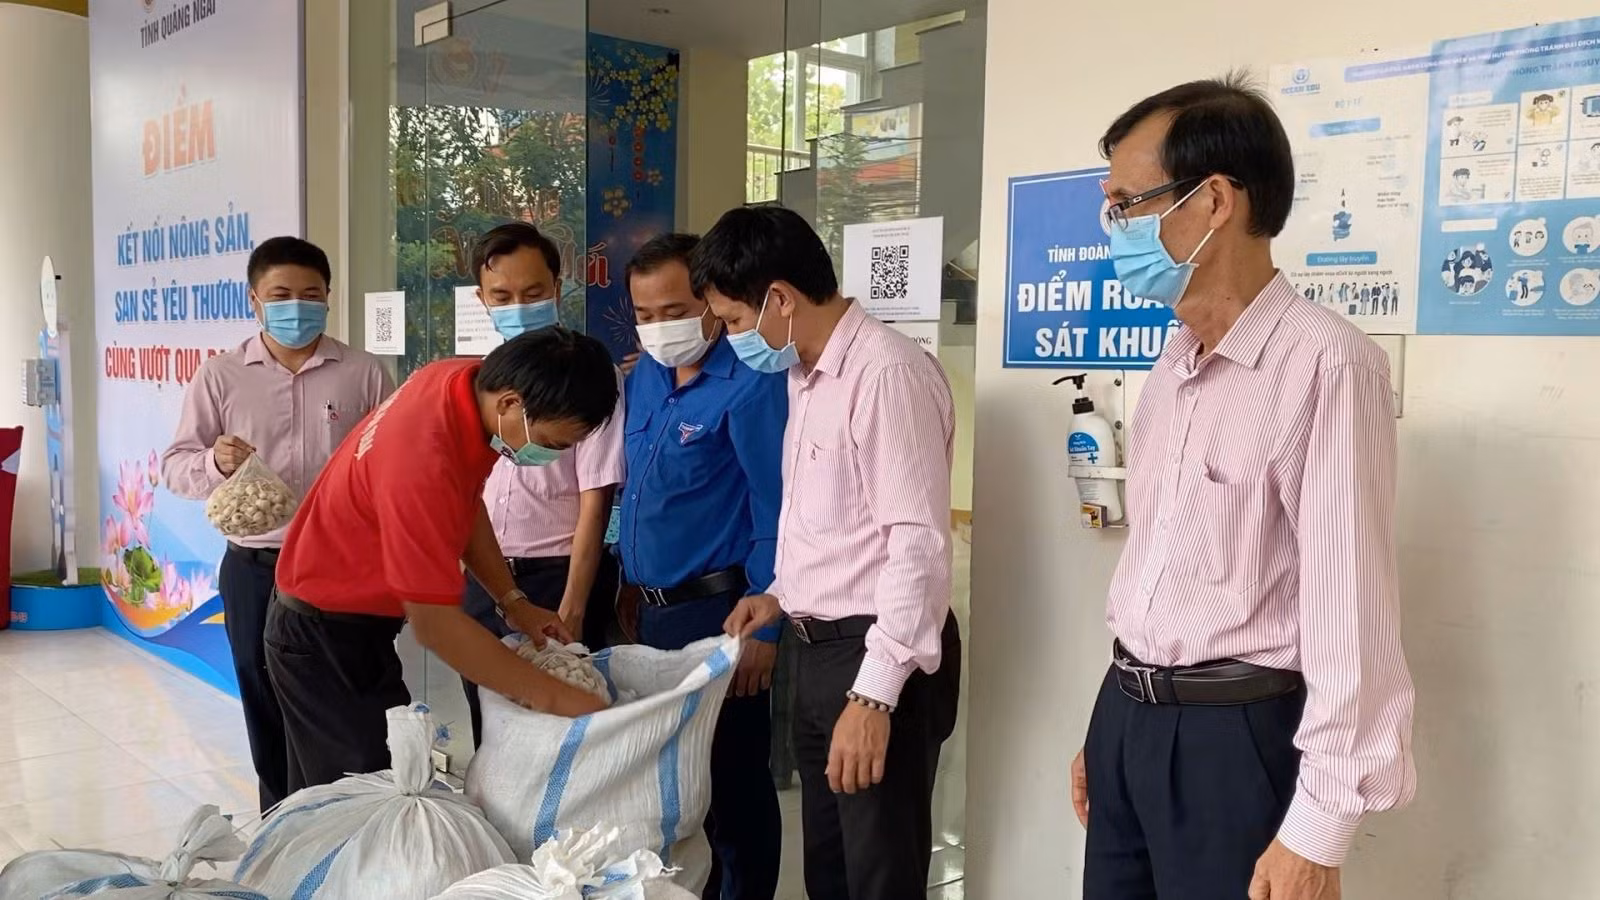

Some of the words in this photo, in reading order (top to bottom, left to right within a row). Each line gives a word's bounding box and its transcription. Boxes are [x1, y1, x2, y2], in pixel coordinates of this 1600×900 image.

[140, 19, 160, 49] TỈNH
[161, 4, 190, 40] QUẢNG
[142, 83, 216, 178] ĐIỂM
[117, 221, 139, 266] KẾT
[142, 215, 164, 263] NỐI
[169, 215, 210, 260] NÔNG
[1048, 244, 1076, 263] TỈNH
[115, 289, 138, 322] SAN
[142, 276, 157, 322] SẺ
[162, 278, 187, 321] YÊU
[192, 278, 256, 320] THƯƠNG
[1017, 269, 1092, 312] ĐIỂM
[1035, 321, 1089, 358] SÁT
[105, 340, 136, 379] CÙNG
[139, 344, 170, 389] VƯỢT
